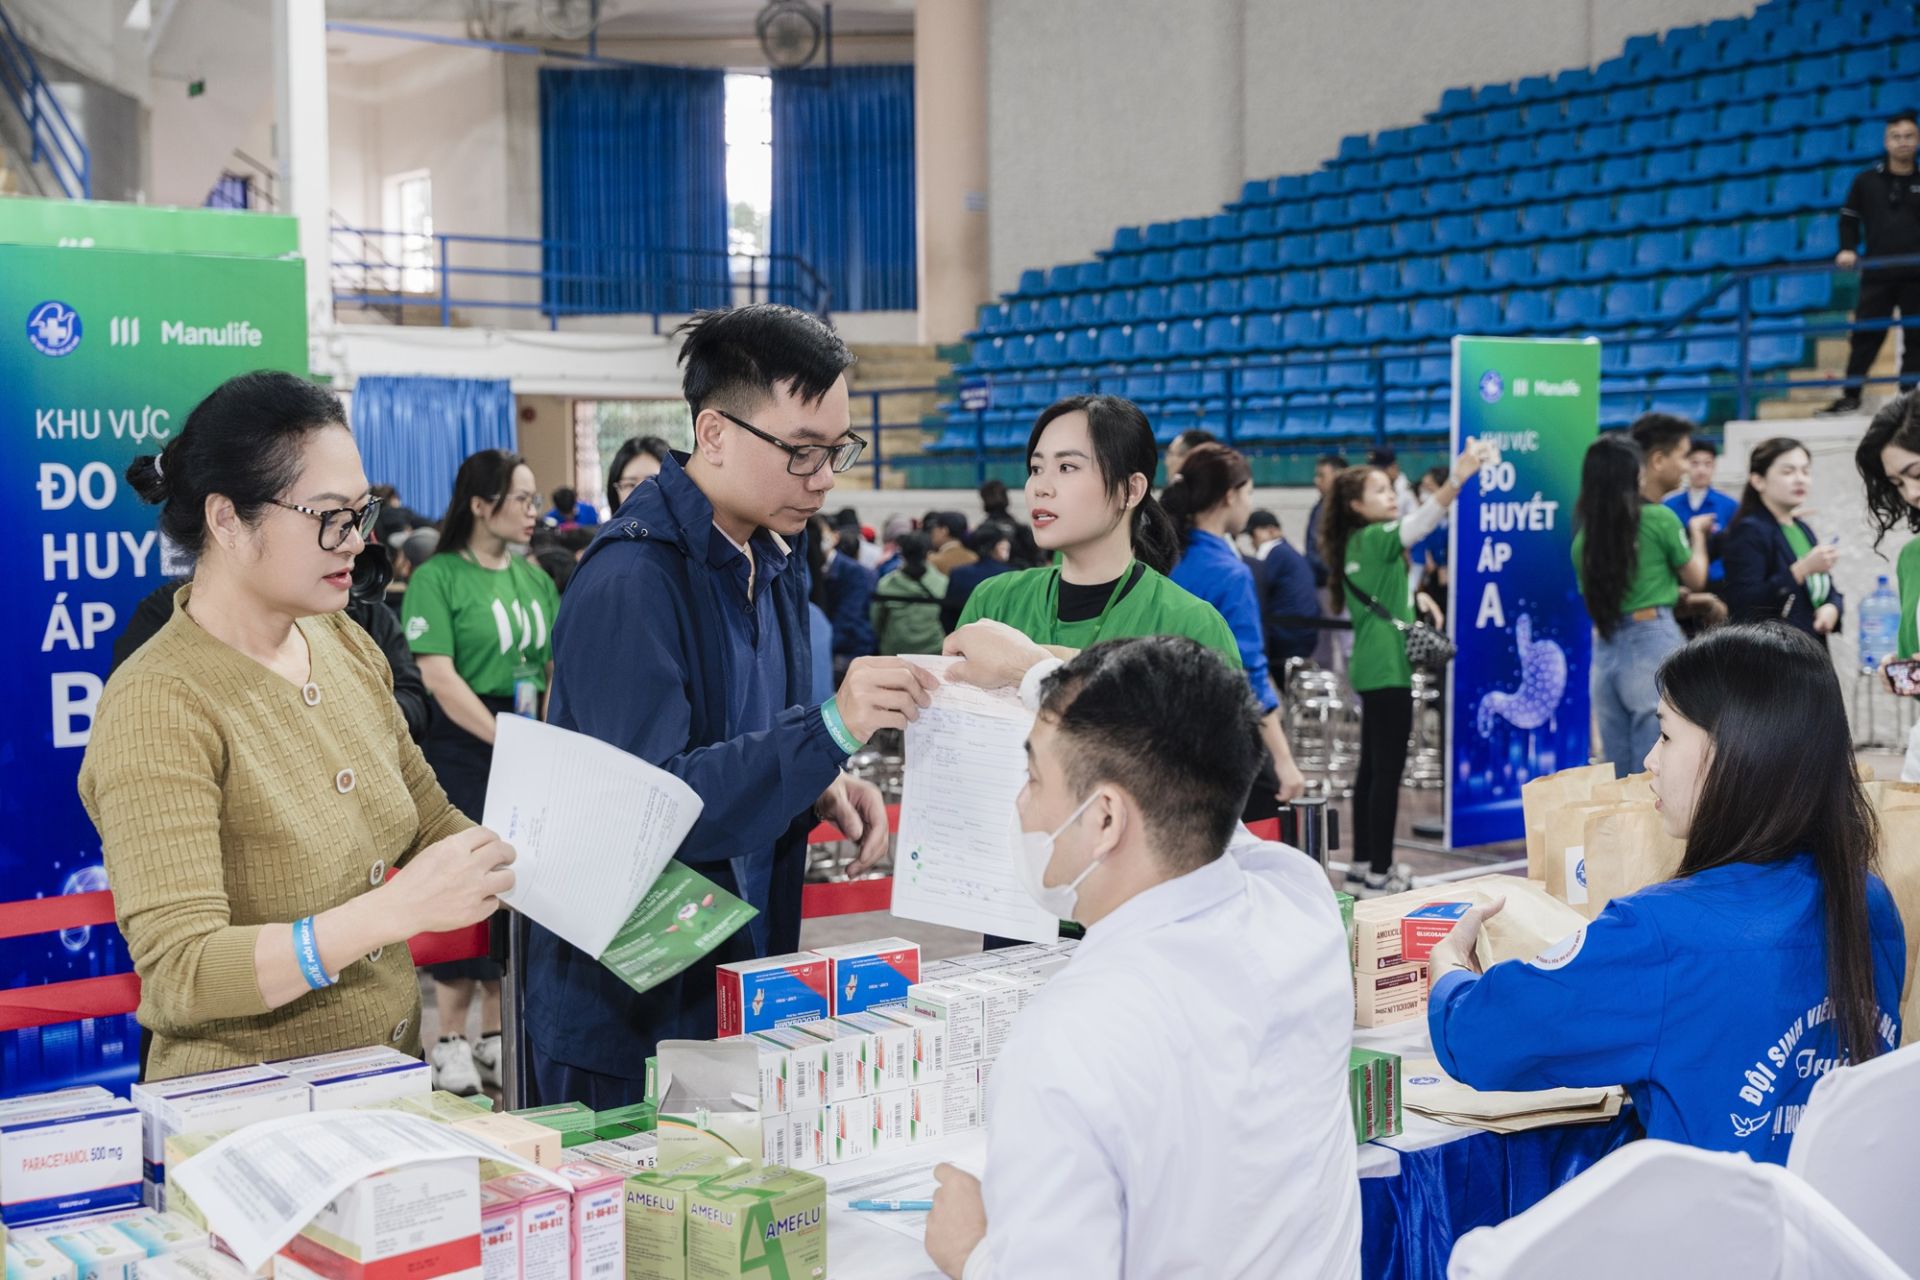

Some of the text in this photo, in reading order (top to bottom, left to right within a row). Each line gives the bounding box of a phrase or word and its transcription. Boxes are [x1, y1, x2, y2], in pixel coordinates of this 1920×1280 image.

[161, 320, 262, 347] Manulife
[1534, 380, 1581, 397] Manulife
[35, 405, 171, 445] KHU VỰC
[37, 463, 117, 511] ĐO
[1480, 491, 1559, 532] HUYẾT
[1476, 536, 1512, 573] ÁP
[41, 592, 116, 653] ÁP
[1475, 583, 1506, 629] A
[50, 671, 104, 748] B
[1739, 1061, 1776, 1106] ĐỘI
[1767, 1017, 1802, 1068] SINH
[22, 1145, 123, 1173] PARACETAMOL 500 mg
[626, 1191, 675, 1211] AMEFLU
[690, 1203, 733, 1227] AMEFLU
[765, 1206, 822, 1241] AMEFLU
